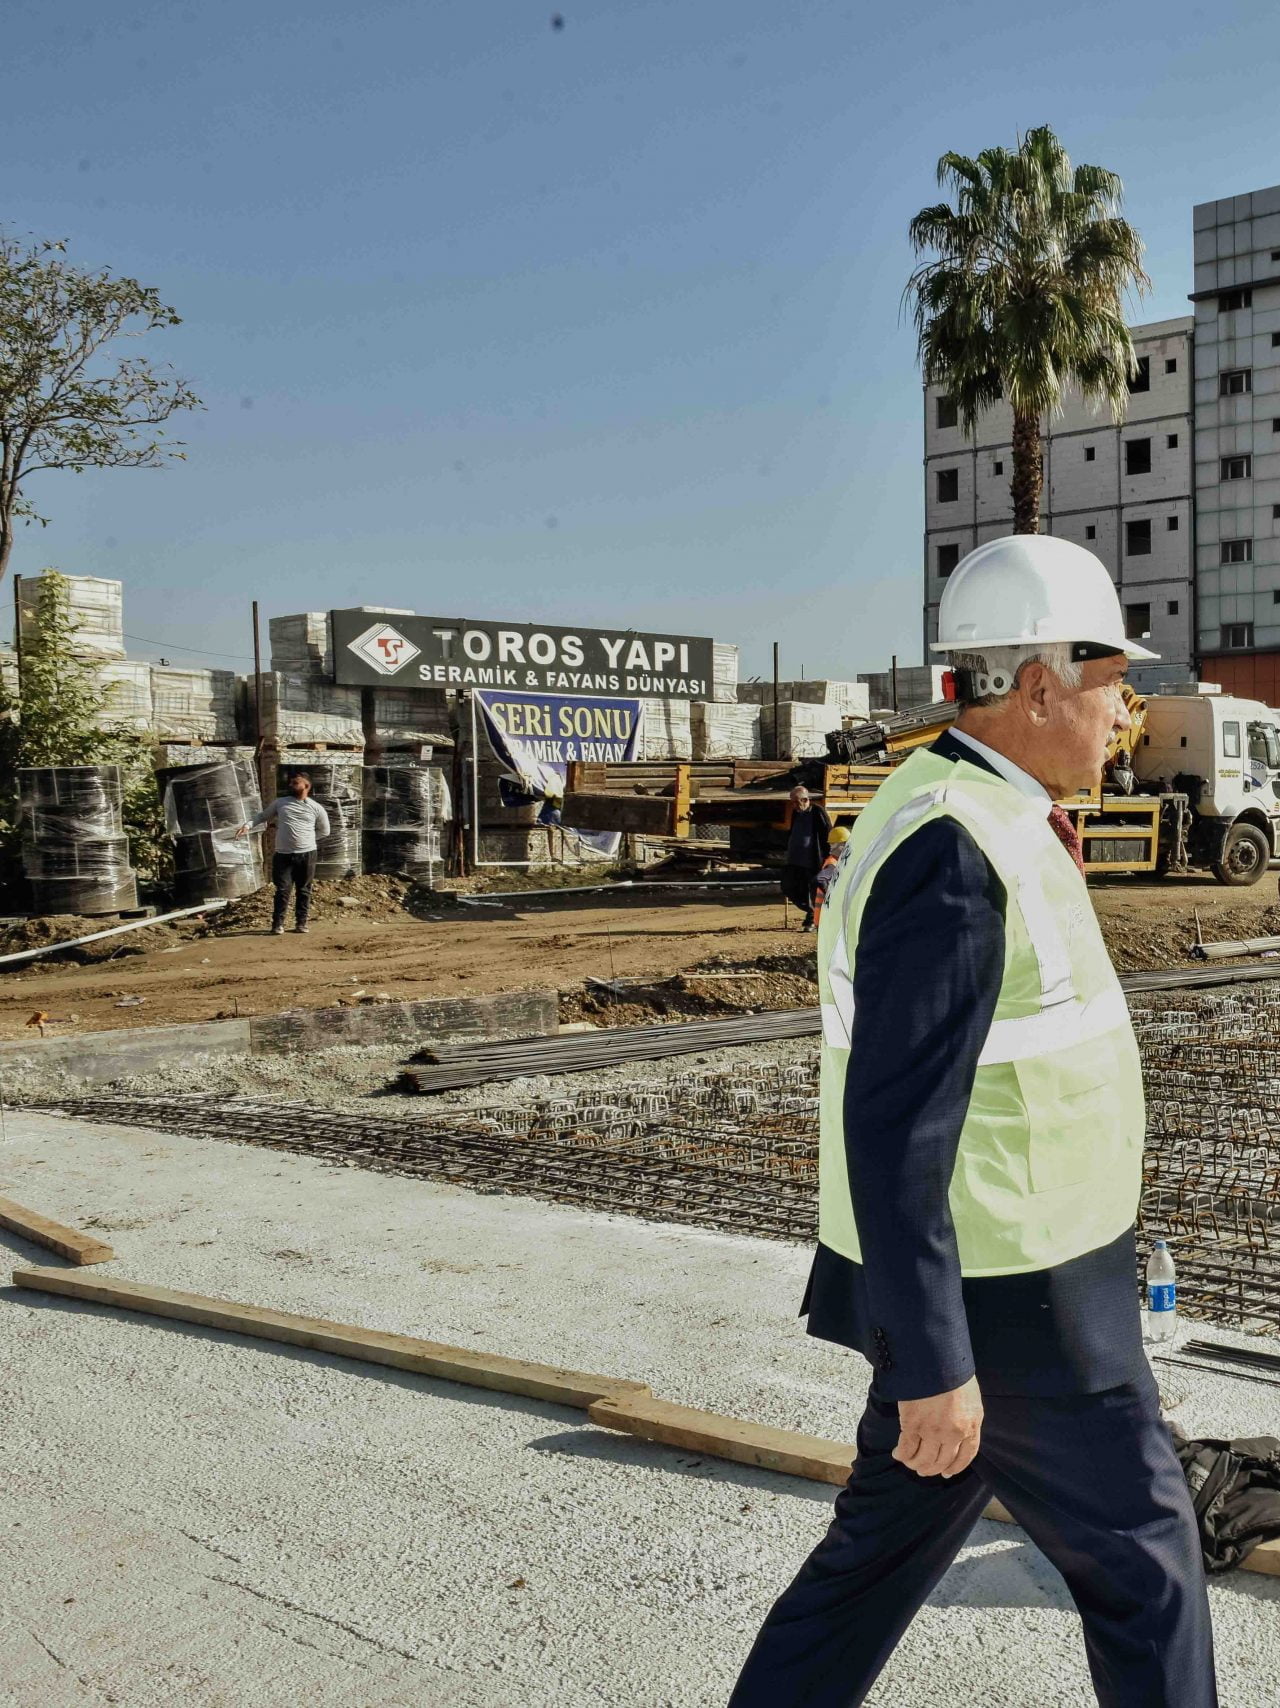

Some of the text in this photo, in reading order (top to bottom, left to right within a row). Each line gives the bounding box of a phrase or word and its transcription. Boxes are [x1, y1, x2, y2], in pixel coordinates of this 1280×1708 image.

[432, 627, 689, 673] TOROS YAPI
[418, 664, 706, 695] SERAMİK & FAYANS DÜNYASI
[558, 706, 632, 740] SONU
[566, 741, 577, 762] &
[580, 742, 627, 763] FAYAN
